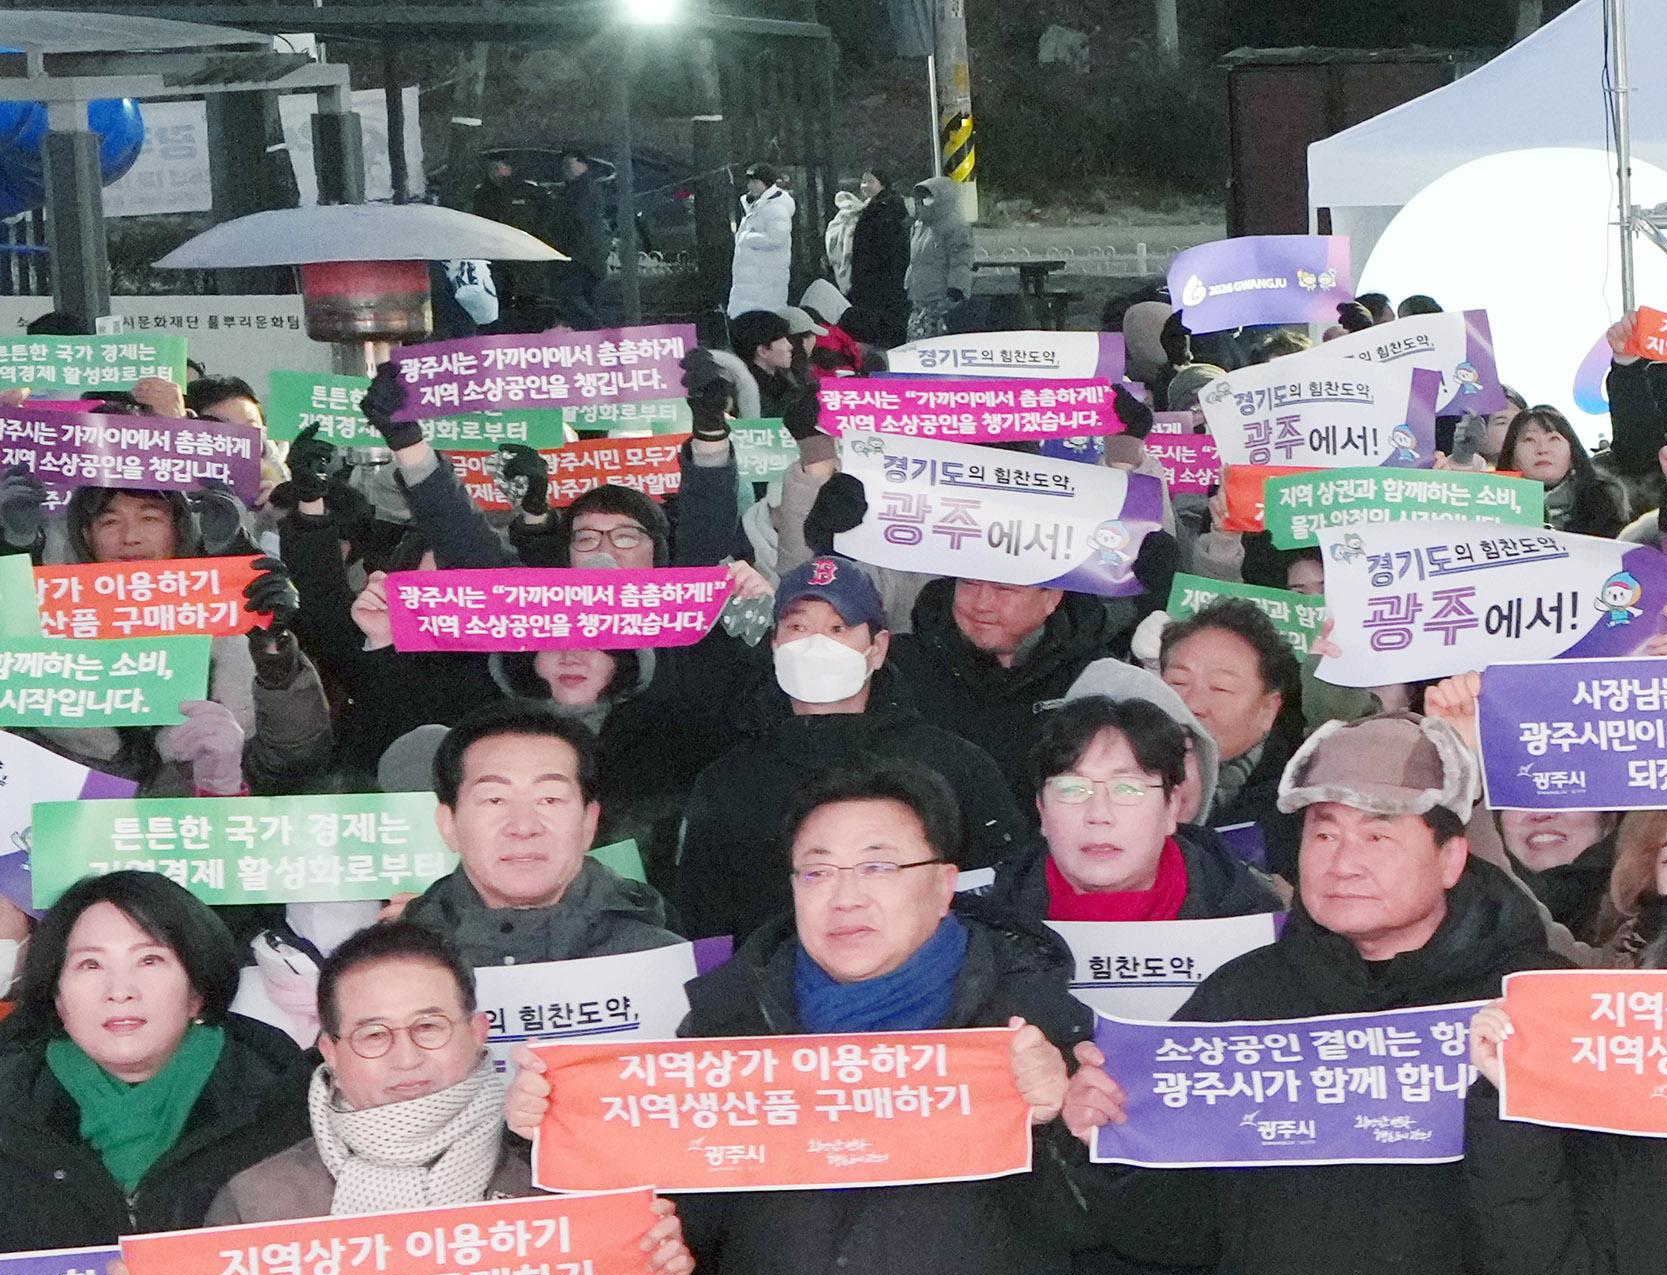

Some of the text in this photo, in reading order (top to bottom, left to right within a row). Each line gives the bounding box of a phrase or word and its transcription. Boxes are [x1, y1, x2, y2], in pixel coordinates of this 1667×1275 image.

[1209, 277, 1287, 295] 2026 GWANGJU
[400, 336, 684, 383] 광주시는 가까이에서 촘촘하게
[420, 382, 460, 407] 지역
[463, 374, 569, 402] 소상공인을
[399, 584, 487, 611] 광주시는
[417, 614, 459, 638] 지역
[465, 613, 571, 637] 소상공인을
[1519, 718, 1662, 755] 광주시민이
[1531, 769, 1586, 794] 광주시
[111, 812, 409, 852] 튼튼한 국가 경제는
[238, 854, 448, 891] 활성화로부터
[1156, 1027, 1420, 1066] 소상공인 곁에는
[618, 1045, 947, 1087] 지역상가 이용하기
[1153, 1067, 1386, 1105] 광주시가 함께
[602, 1085, 971, 1129] 지역생산품 구매하기
[1256, 1120, 1316, 1140] 광주시
[706, 1144, 765, 1165] 광주시
[405, 1218, 572, 1265] 이용하기
